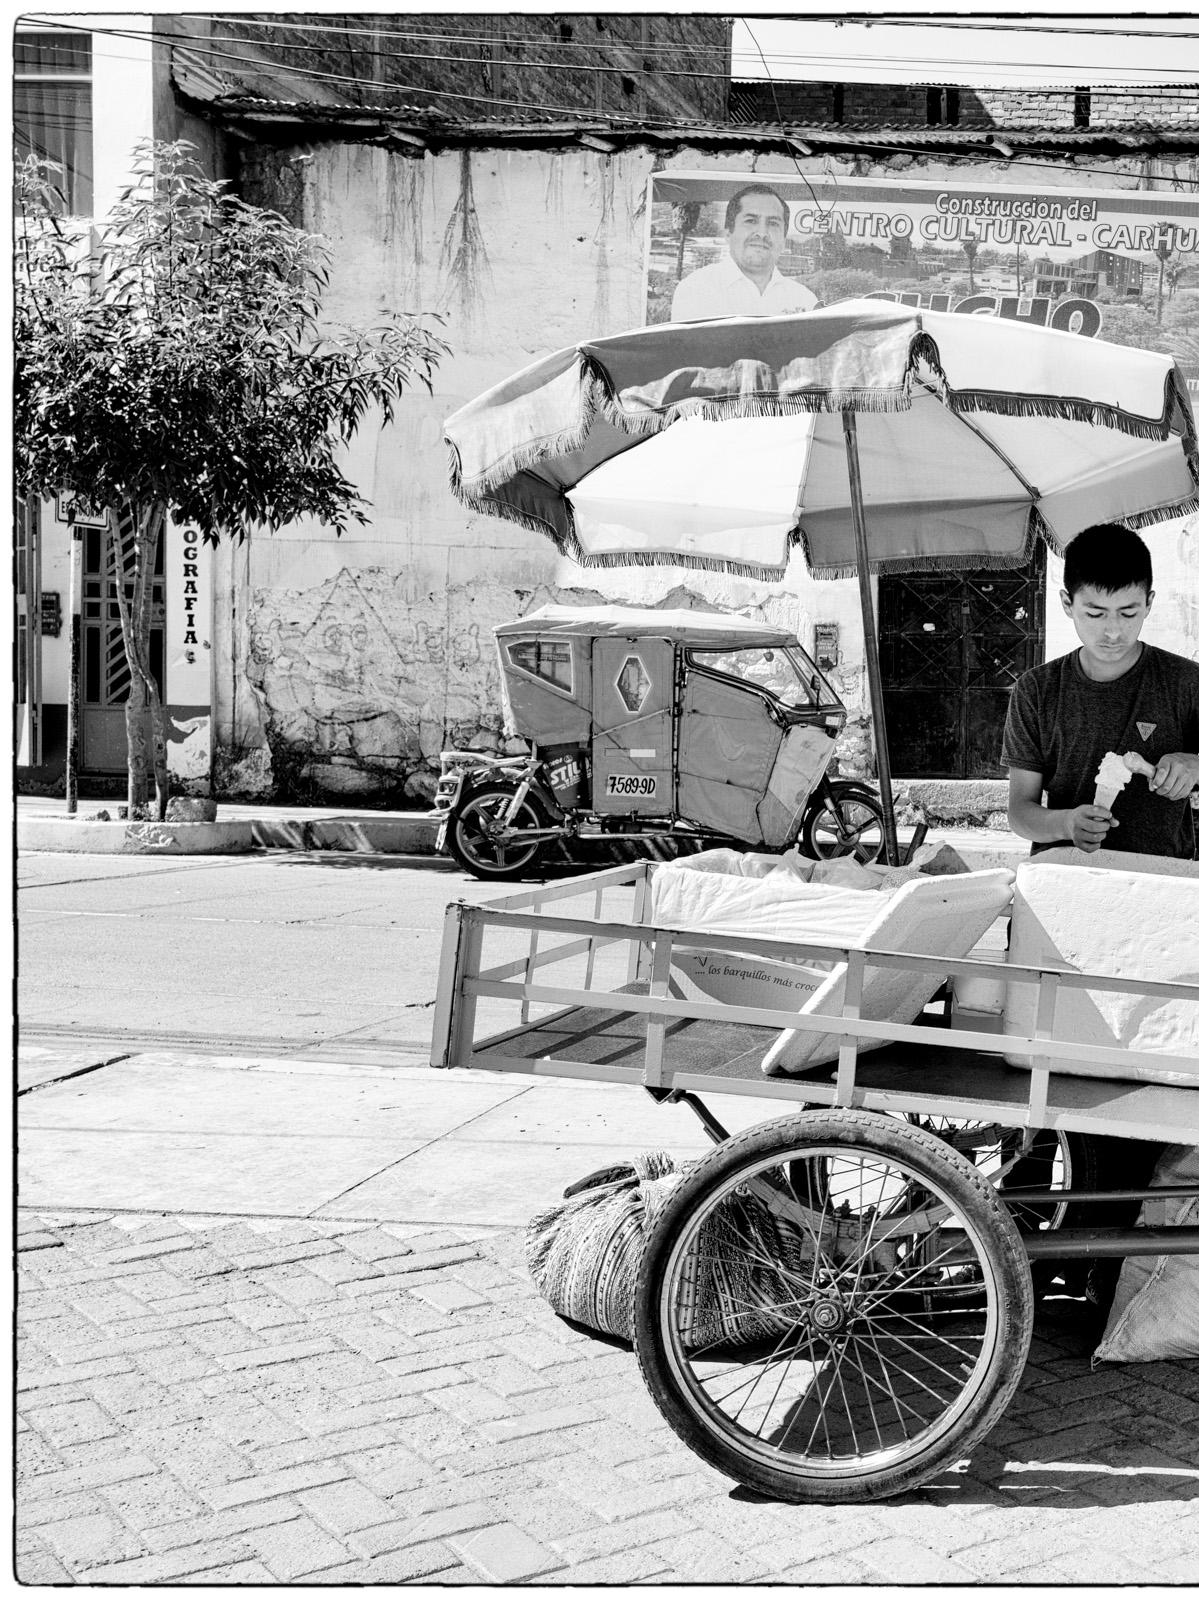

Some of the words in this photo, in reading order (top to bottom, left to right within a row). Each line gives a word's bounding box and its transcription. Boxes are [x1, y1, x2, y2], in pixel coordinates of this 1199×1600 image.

[935, 192, 1064, 220] Construcción
[1067, 199, 1098, 221] del
[793, 208, 914, 239] CENTRO
[920, 213, 1072, 247] CULTURAL
[609, 776, 656, 795] 7589-9D
[708, 964, 721, 976] los
[723, 966, 771, 982] barquillos
[773, 976, 793, 988] más
